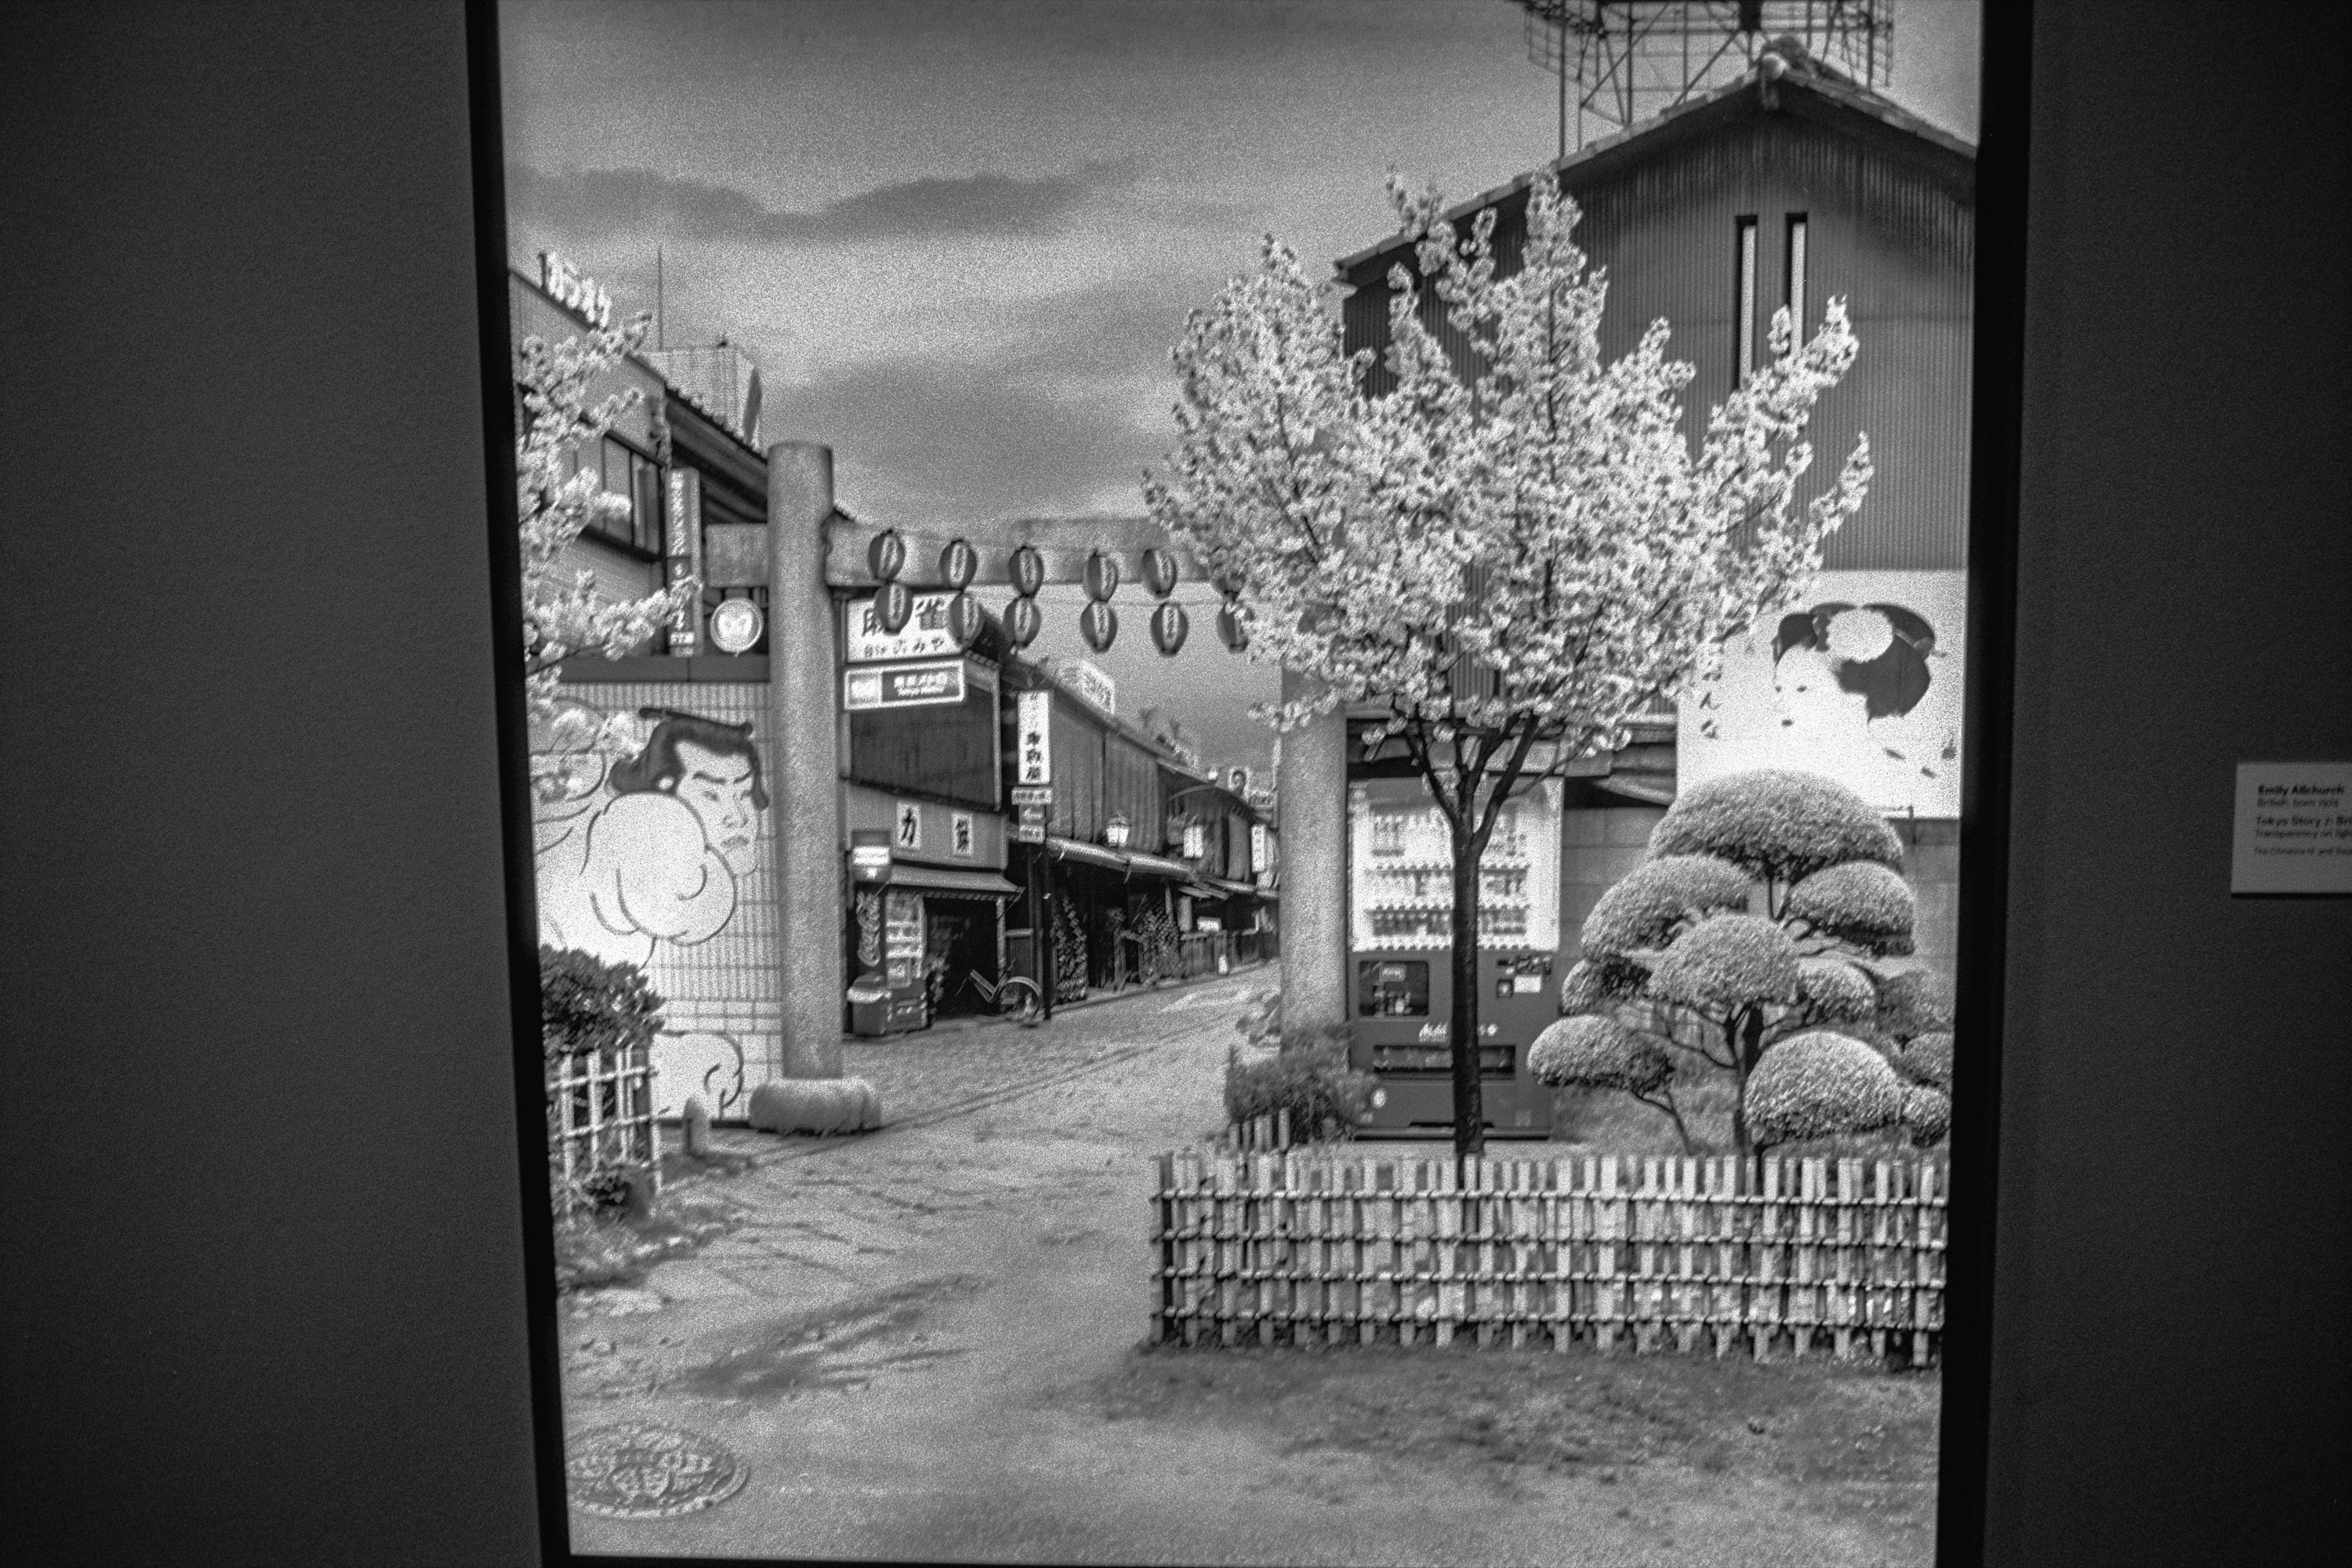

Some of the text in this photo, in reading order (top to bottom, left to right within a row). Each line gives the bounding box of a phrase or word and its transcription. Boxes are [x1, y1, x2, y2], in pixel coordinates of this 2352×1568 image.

[2257, 785, 2288, 796] Emily
[2256, 815, 2288, 827] Tokyo
[2291, 815, 2321, 828] Story
